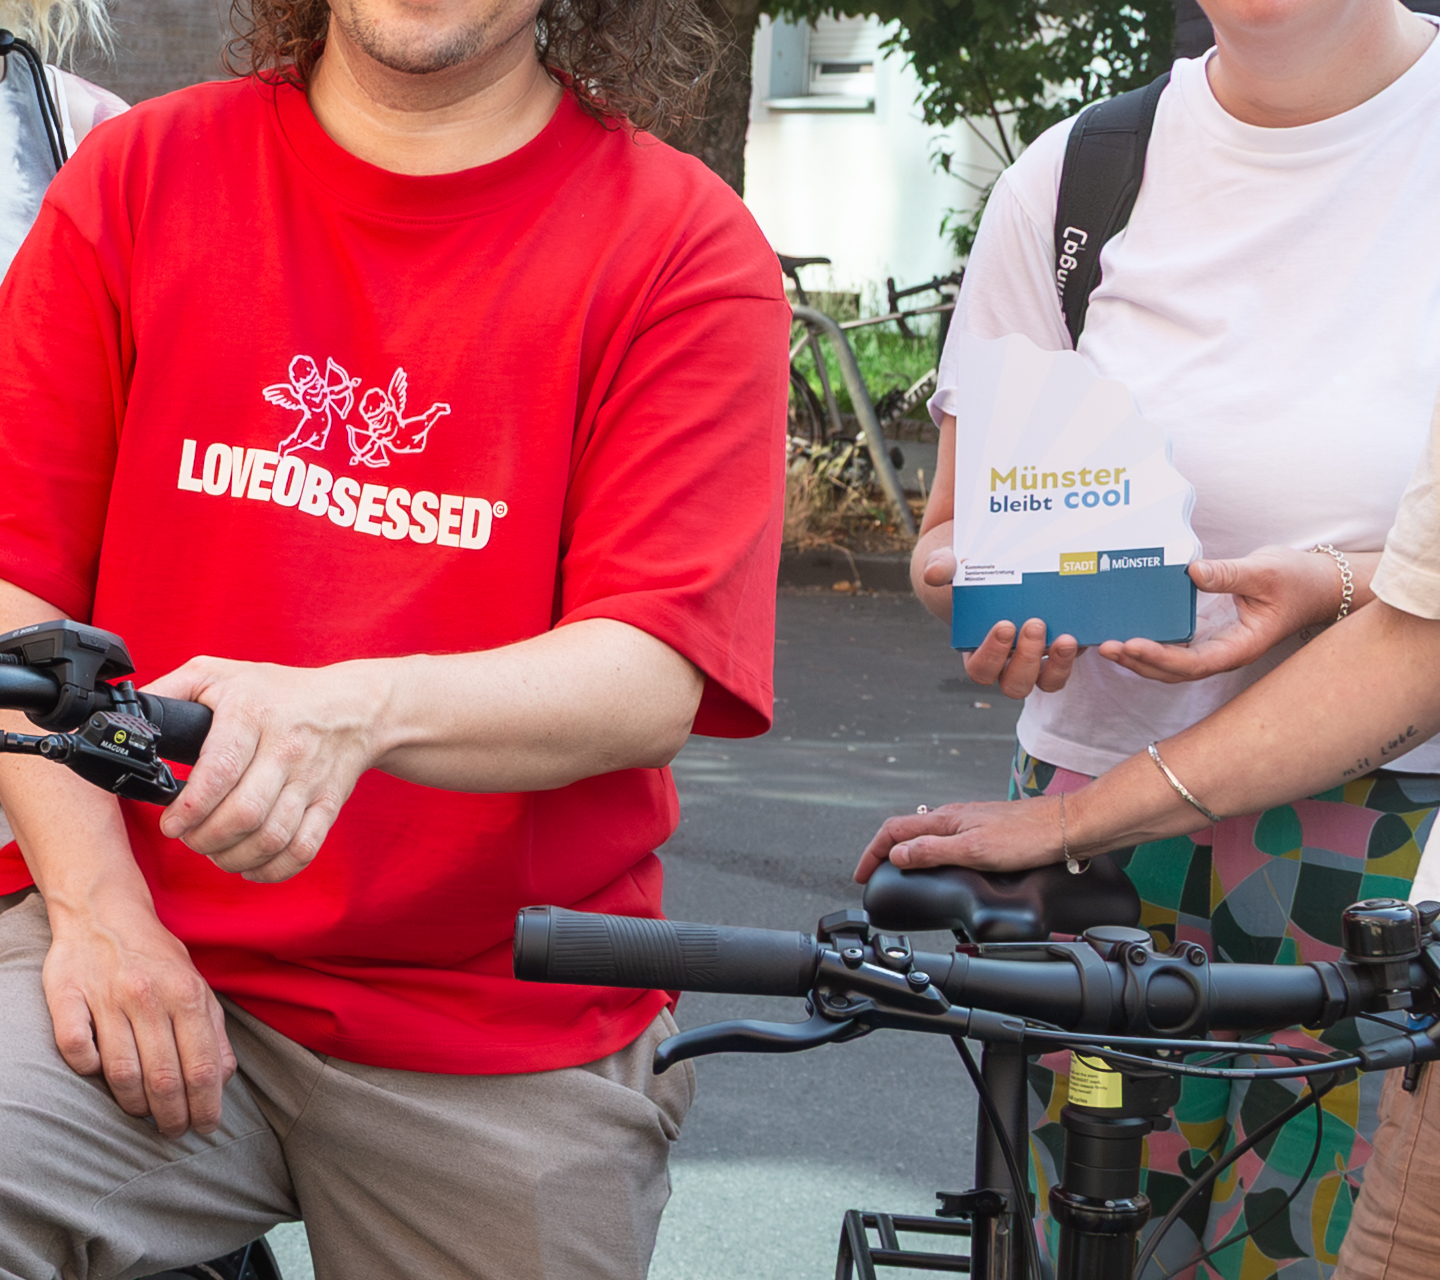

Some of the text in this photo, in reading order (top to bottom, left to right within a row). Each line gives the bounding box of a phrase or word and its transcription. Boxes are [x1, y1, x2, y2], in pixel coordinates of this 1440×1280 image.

[990, 465, 1127, 492] Münster
[989, 479, 1131, 513] bleibt cool
[1063, 555, 1161, 573] STADT MÜNSTER
[100, 740, 130, 757] MAGURA
